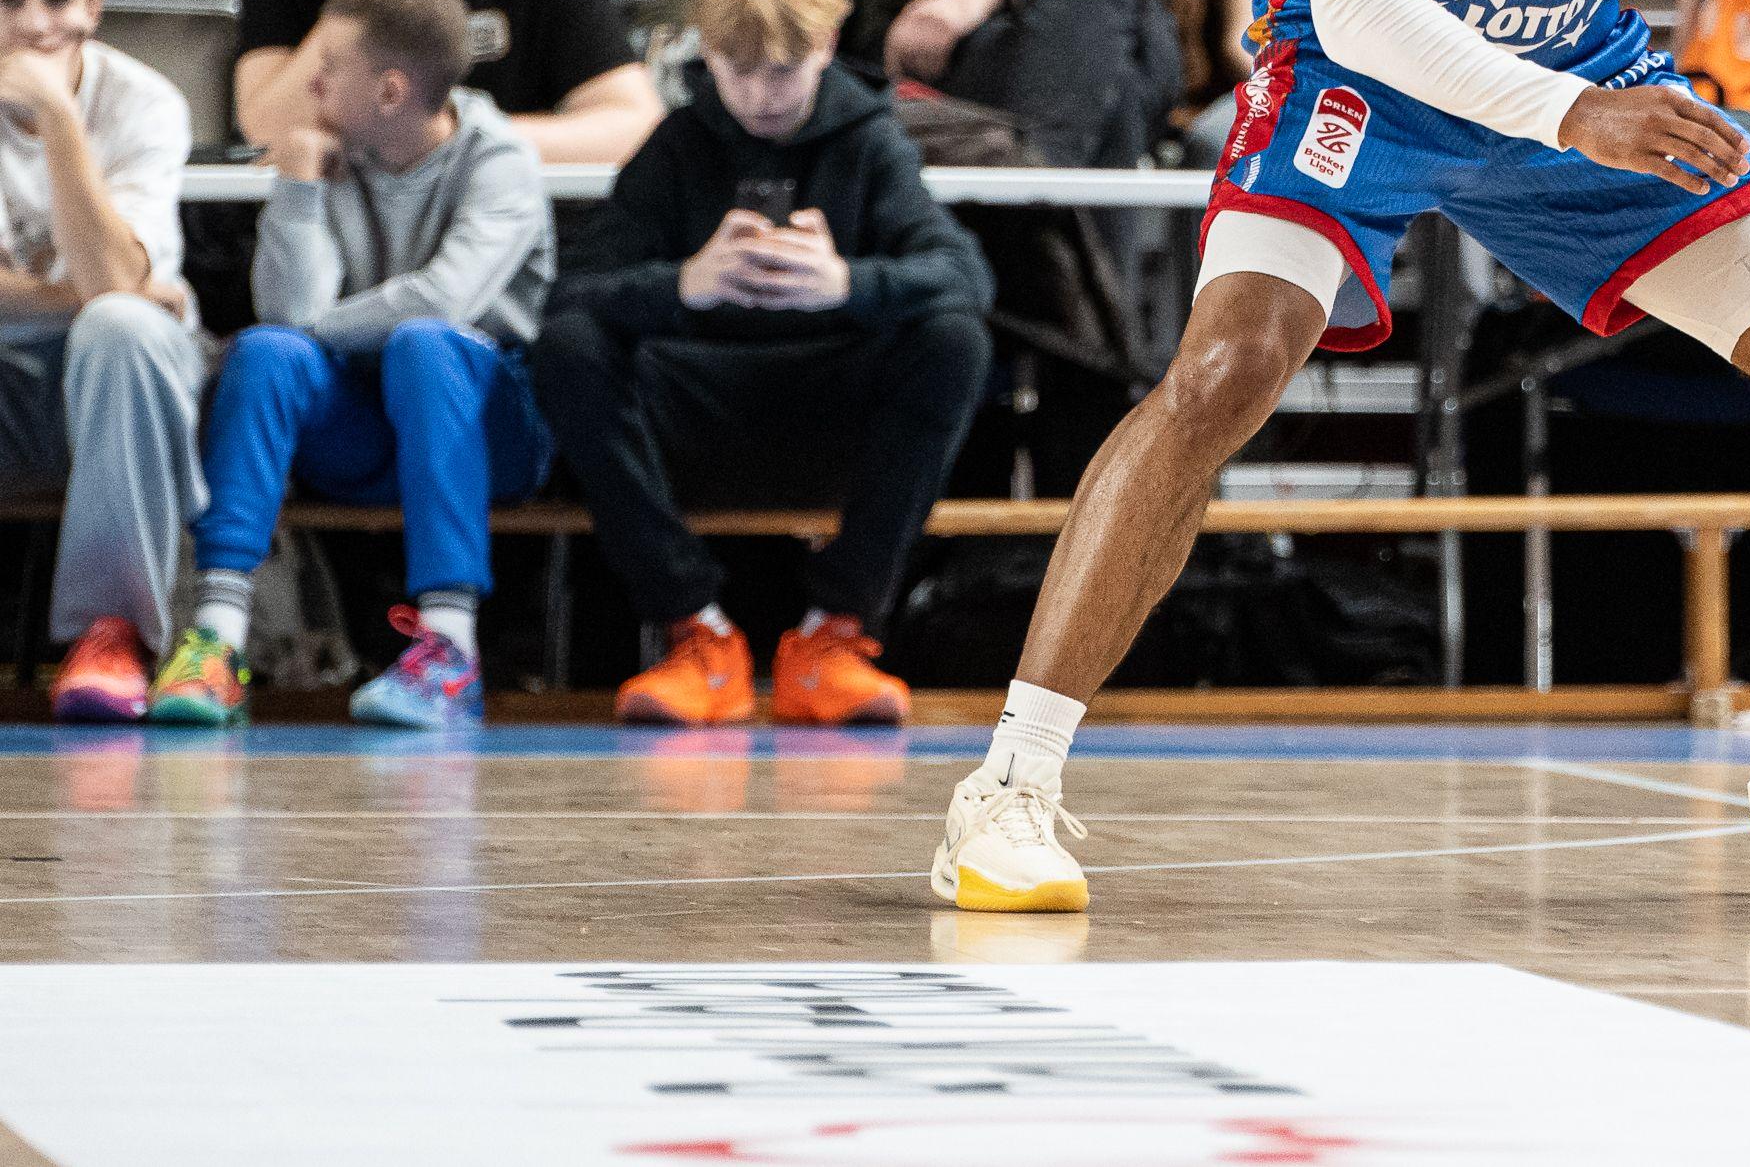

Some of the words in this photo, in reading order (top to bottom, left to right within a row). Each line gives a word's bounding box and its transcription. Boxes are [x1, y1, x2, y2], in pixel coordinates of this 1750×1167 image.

[1322, 98, 1364, 123] ORLEN
[1304, 147, 1345, 173] Basket
[1309, 158, 1335, 177] Liga
